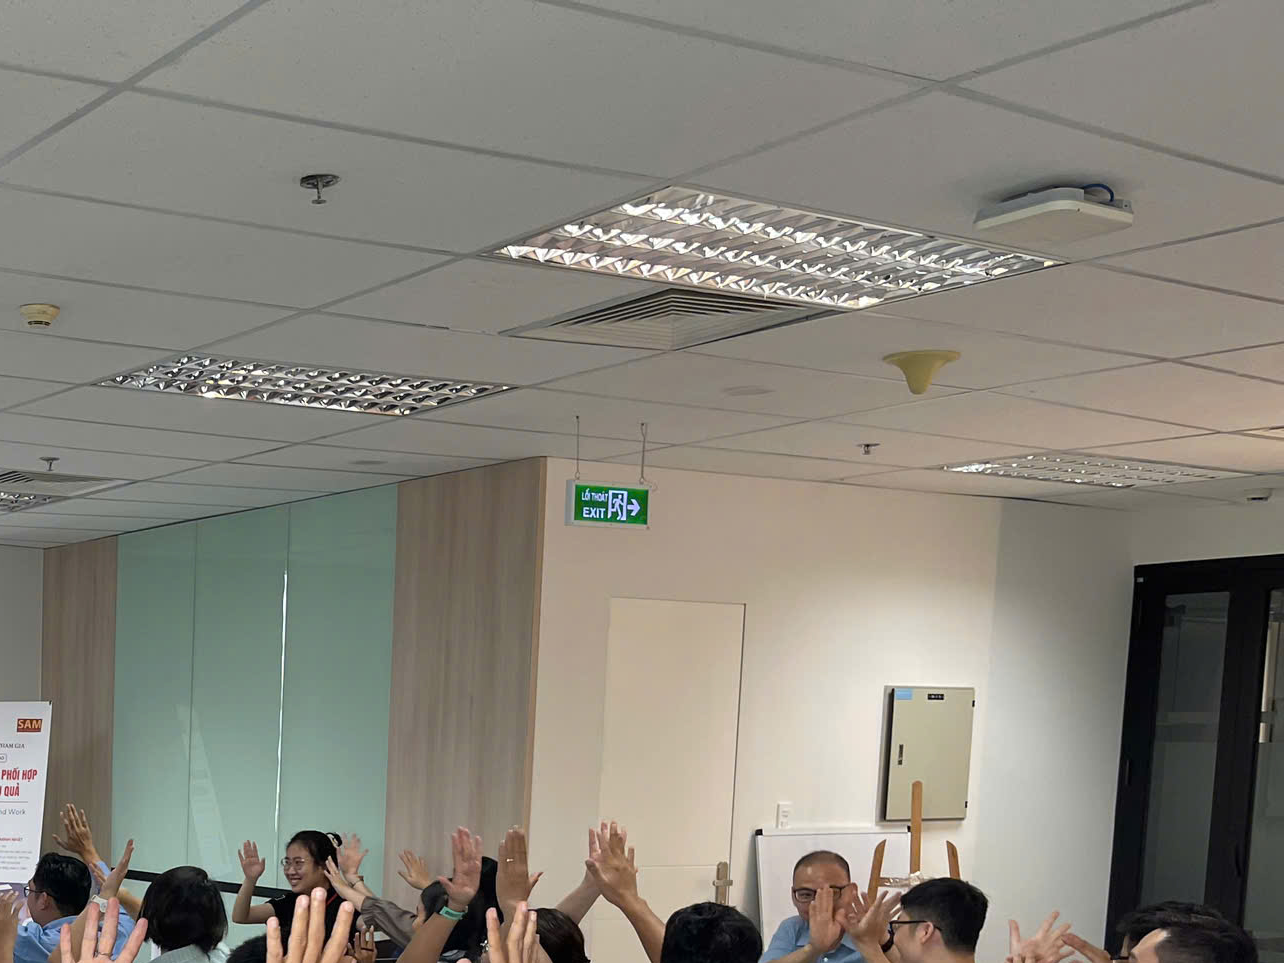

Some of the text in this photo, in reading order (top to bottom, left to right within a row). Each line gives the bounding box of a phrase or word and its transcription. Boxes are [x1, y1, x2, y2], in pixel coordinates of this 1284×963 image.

[583, 507, 605, 518] EXIT
[18, 720, 42, 728] SAM
[22, 768, 38, 782] HỢP
[4, 782, 20, 797] QUẢ
